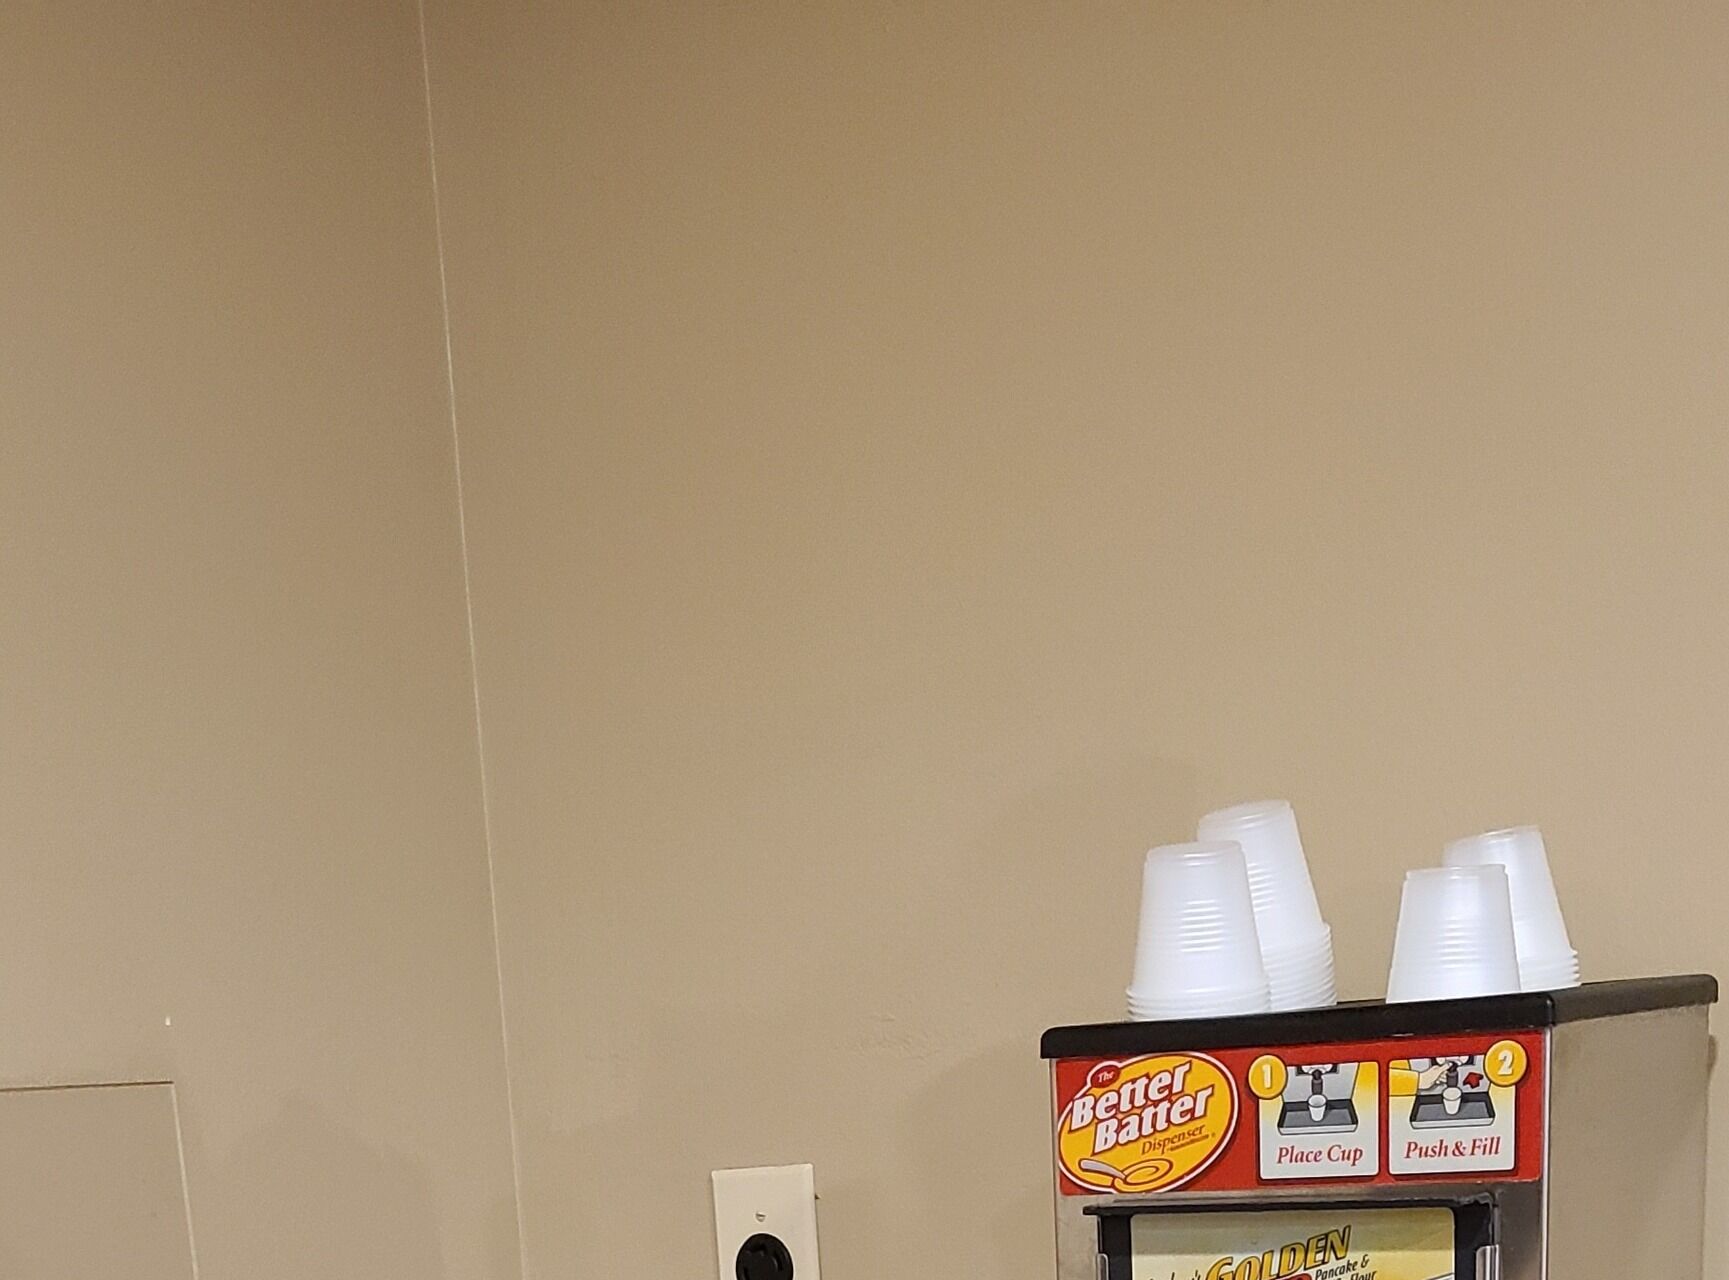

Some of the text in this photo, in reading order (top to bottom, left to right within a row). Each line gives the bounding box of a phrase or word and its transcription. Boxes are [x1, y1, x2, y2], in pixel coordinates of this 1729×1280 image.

[1498, 1050, 1514, 1076] 2
[1097, 1070, 1115, 1083] The
[1261, 1065, 1272, 1089] 1
[1068, 1060, 1192, 1134] Better
[1091, 1084, 1215, 1156] Batter
[1141, 1124, 1206, 1155] Dispenser
[1404, 1136, 1501, 1159] Push & Fill
[1277, 1145, 1363, 1167] Place Cup
[1361, 1254, 1370, 1268] &
